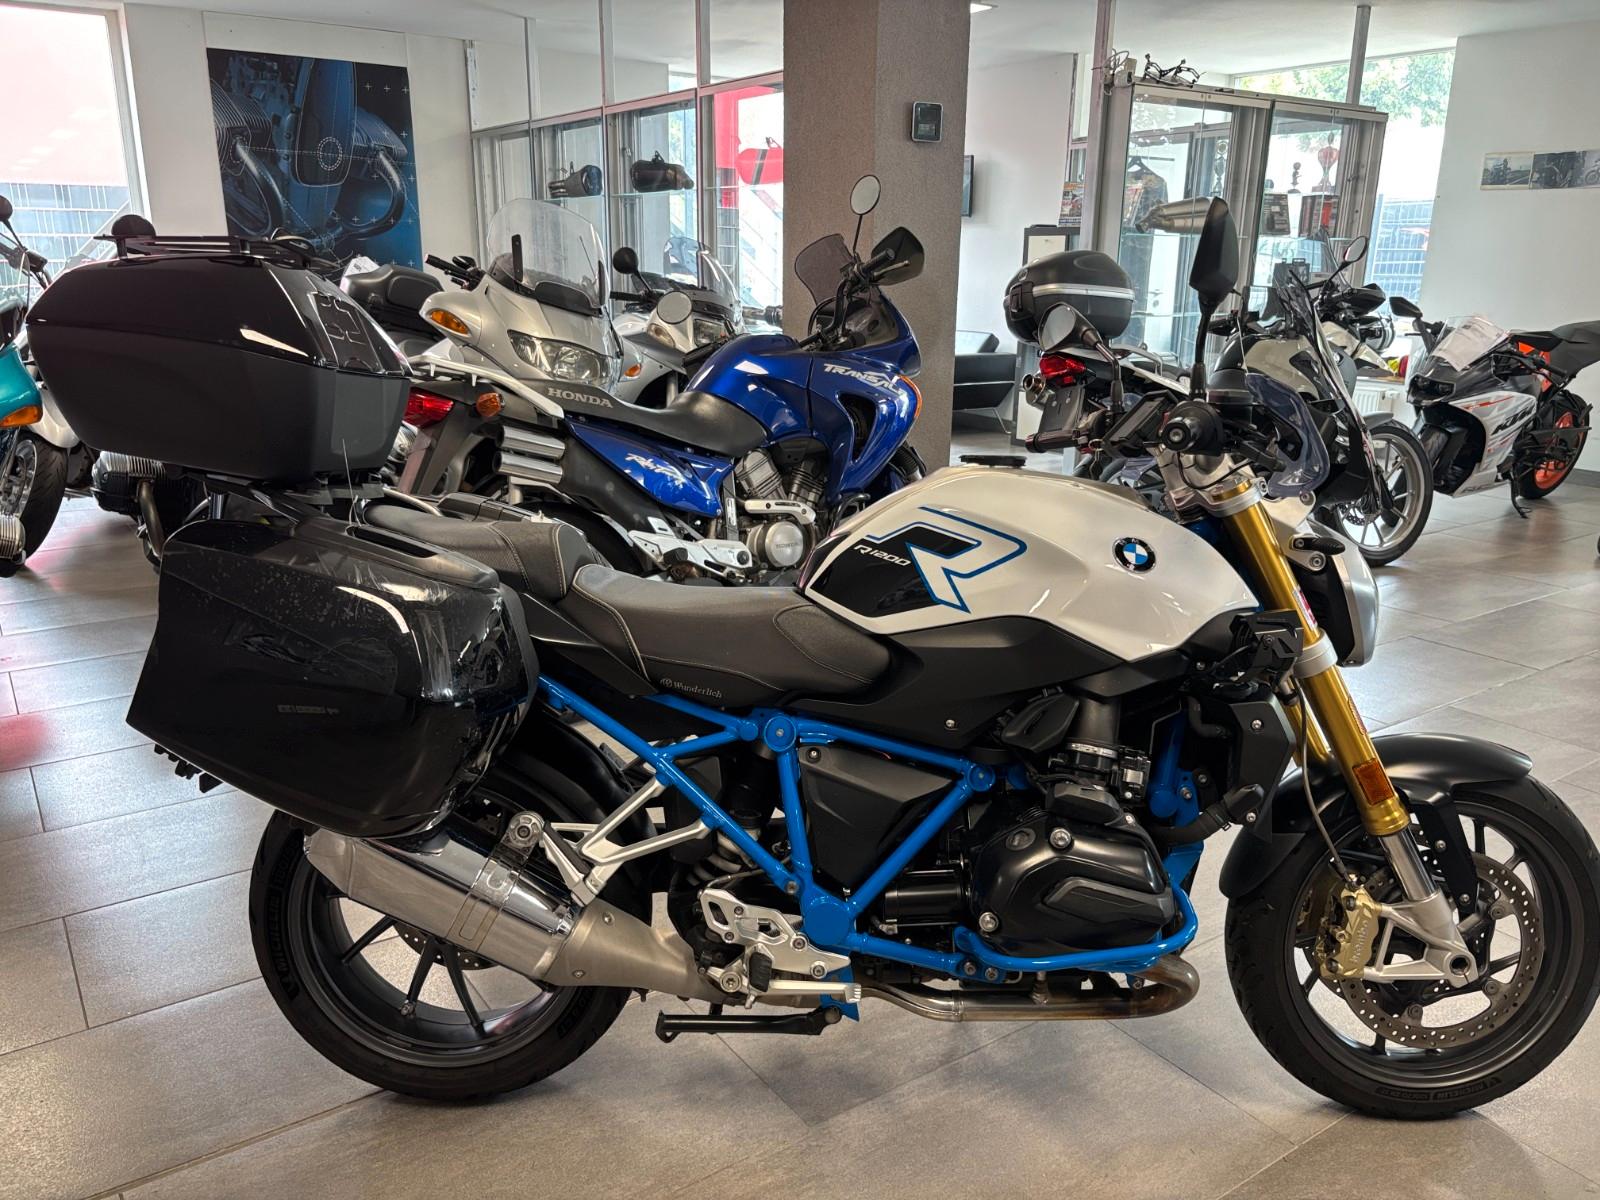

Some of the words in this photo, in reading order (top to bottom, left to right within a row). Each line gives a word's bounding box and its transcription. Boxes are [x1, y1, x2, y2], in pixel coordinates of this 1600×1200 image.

[548, 387, 613, 409] HONDA
[1491, 404, 1536, 436] KTM
[673, 681, 722, 698] Wunderlich
